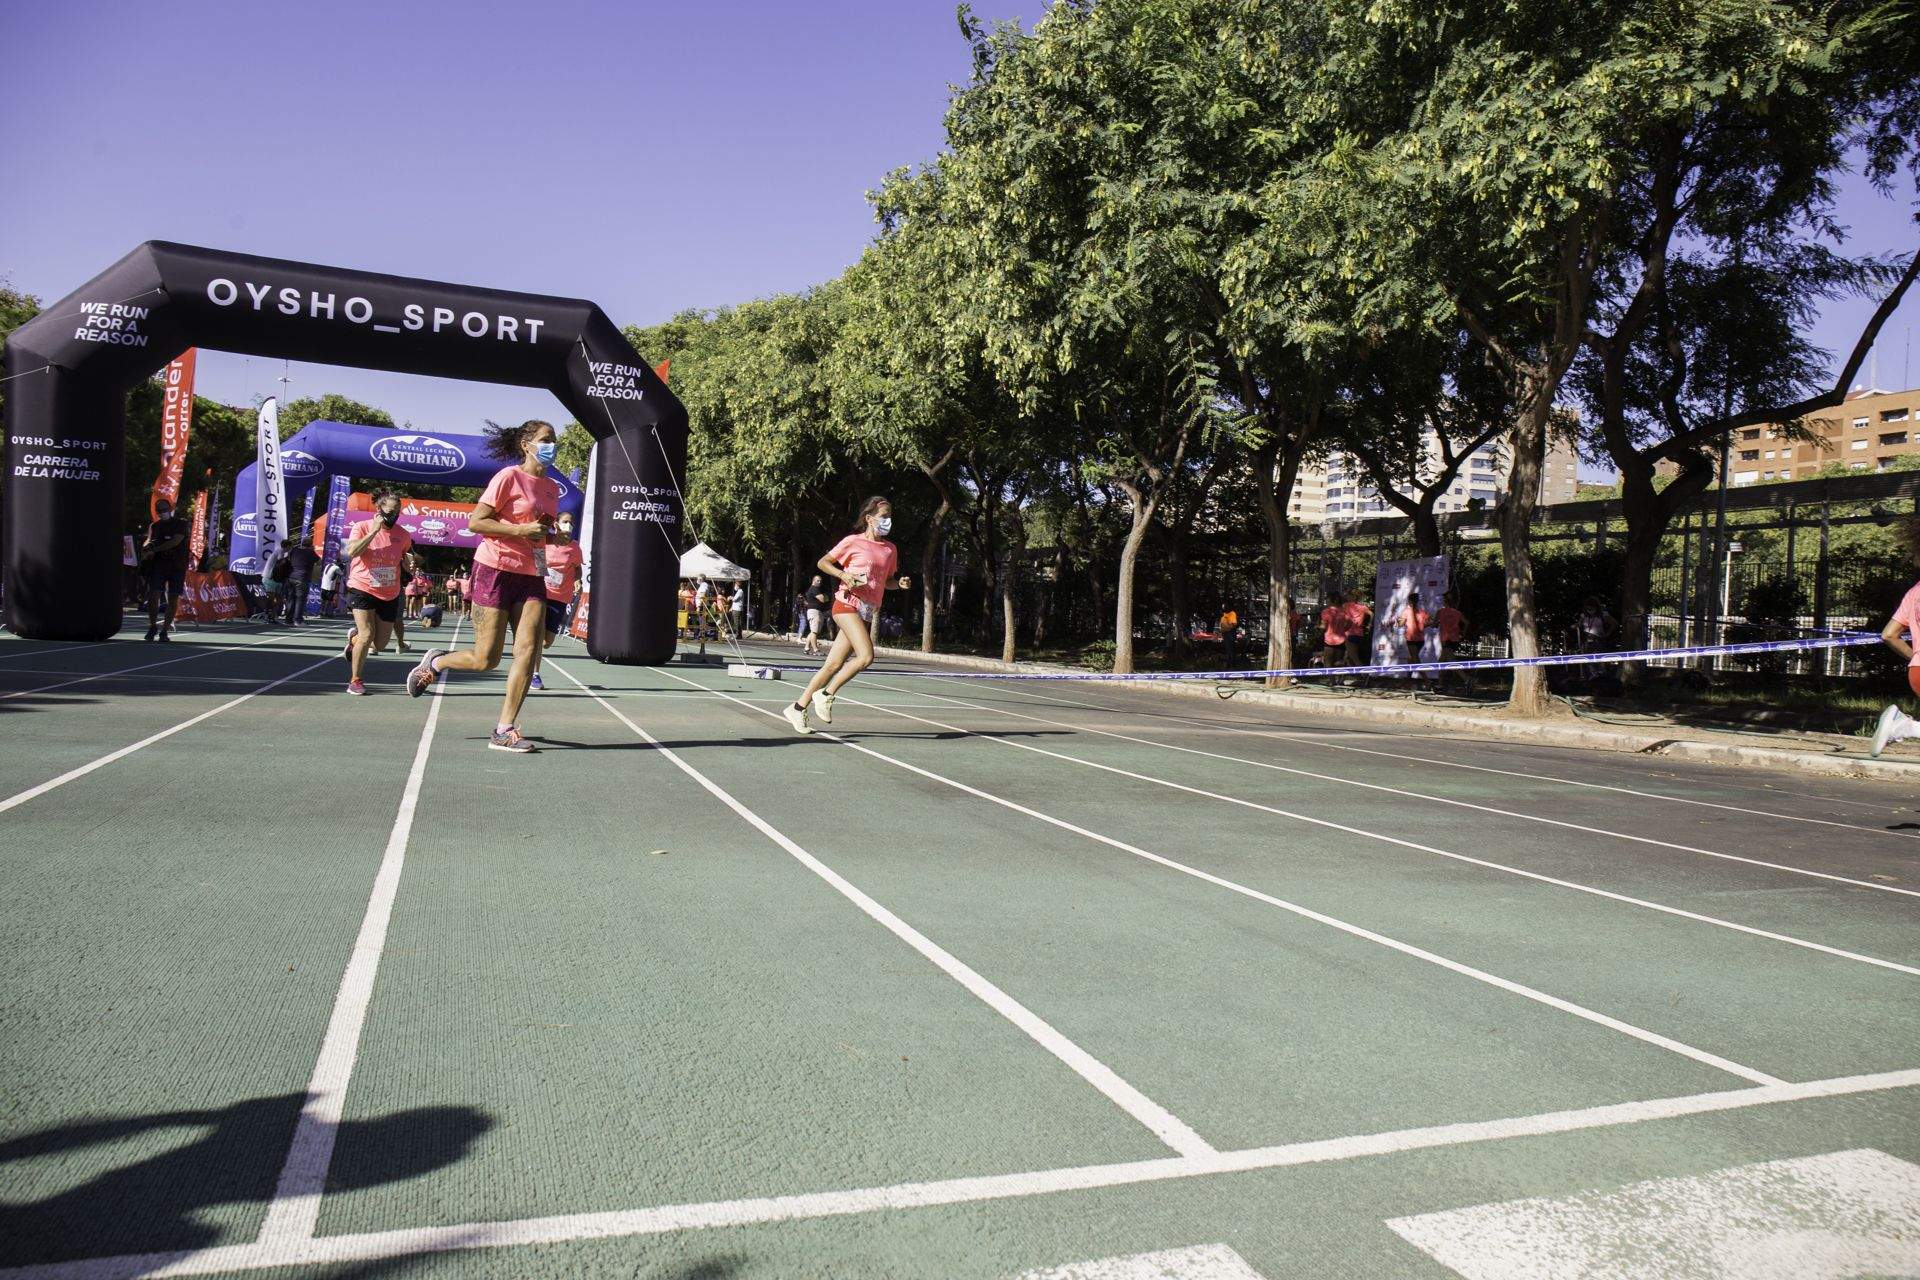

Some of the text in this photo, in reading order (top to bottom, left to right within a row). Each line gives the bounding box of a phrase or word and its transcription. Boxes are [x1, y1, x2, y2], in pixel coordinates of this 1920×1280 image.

[80, 302, 149, 320] WE RUN
[207, 278, 545, 344] OYSHO_SPORT
[86, 315, 138, 333] FOR A
[74, 328, 149, 347] REASON
[589, 361, 642, 378] WE RUN
[595, 374, 636, 388] FOR A
[586, 385, 643, 401] REASON
[11, 435, 108, 450] OYSHO_SPORT
[23, 454, 89, 468] CARRERA
[377, 443, 458, 468] ASTURIANA
[14, 466, 101, 480] DE LA MUJER
[611, 485, 677, 497] OYSHO_SPOR
[622, 501, 670, 512] CARRERA
[613, 511, 676, 524] DE LA MUJER
